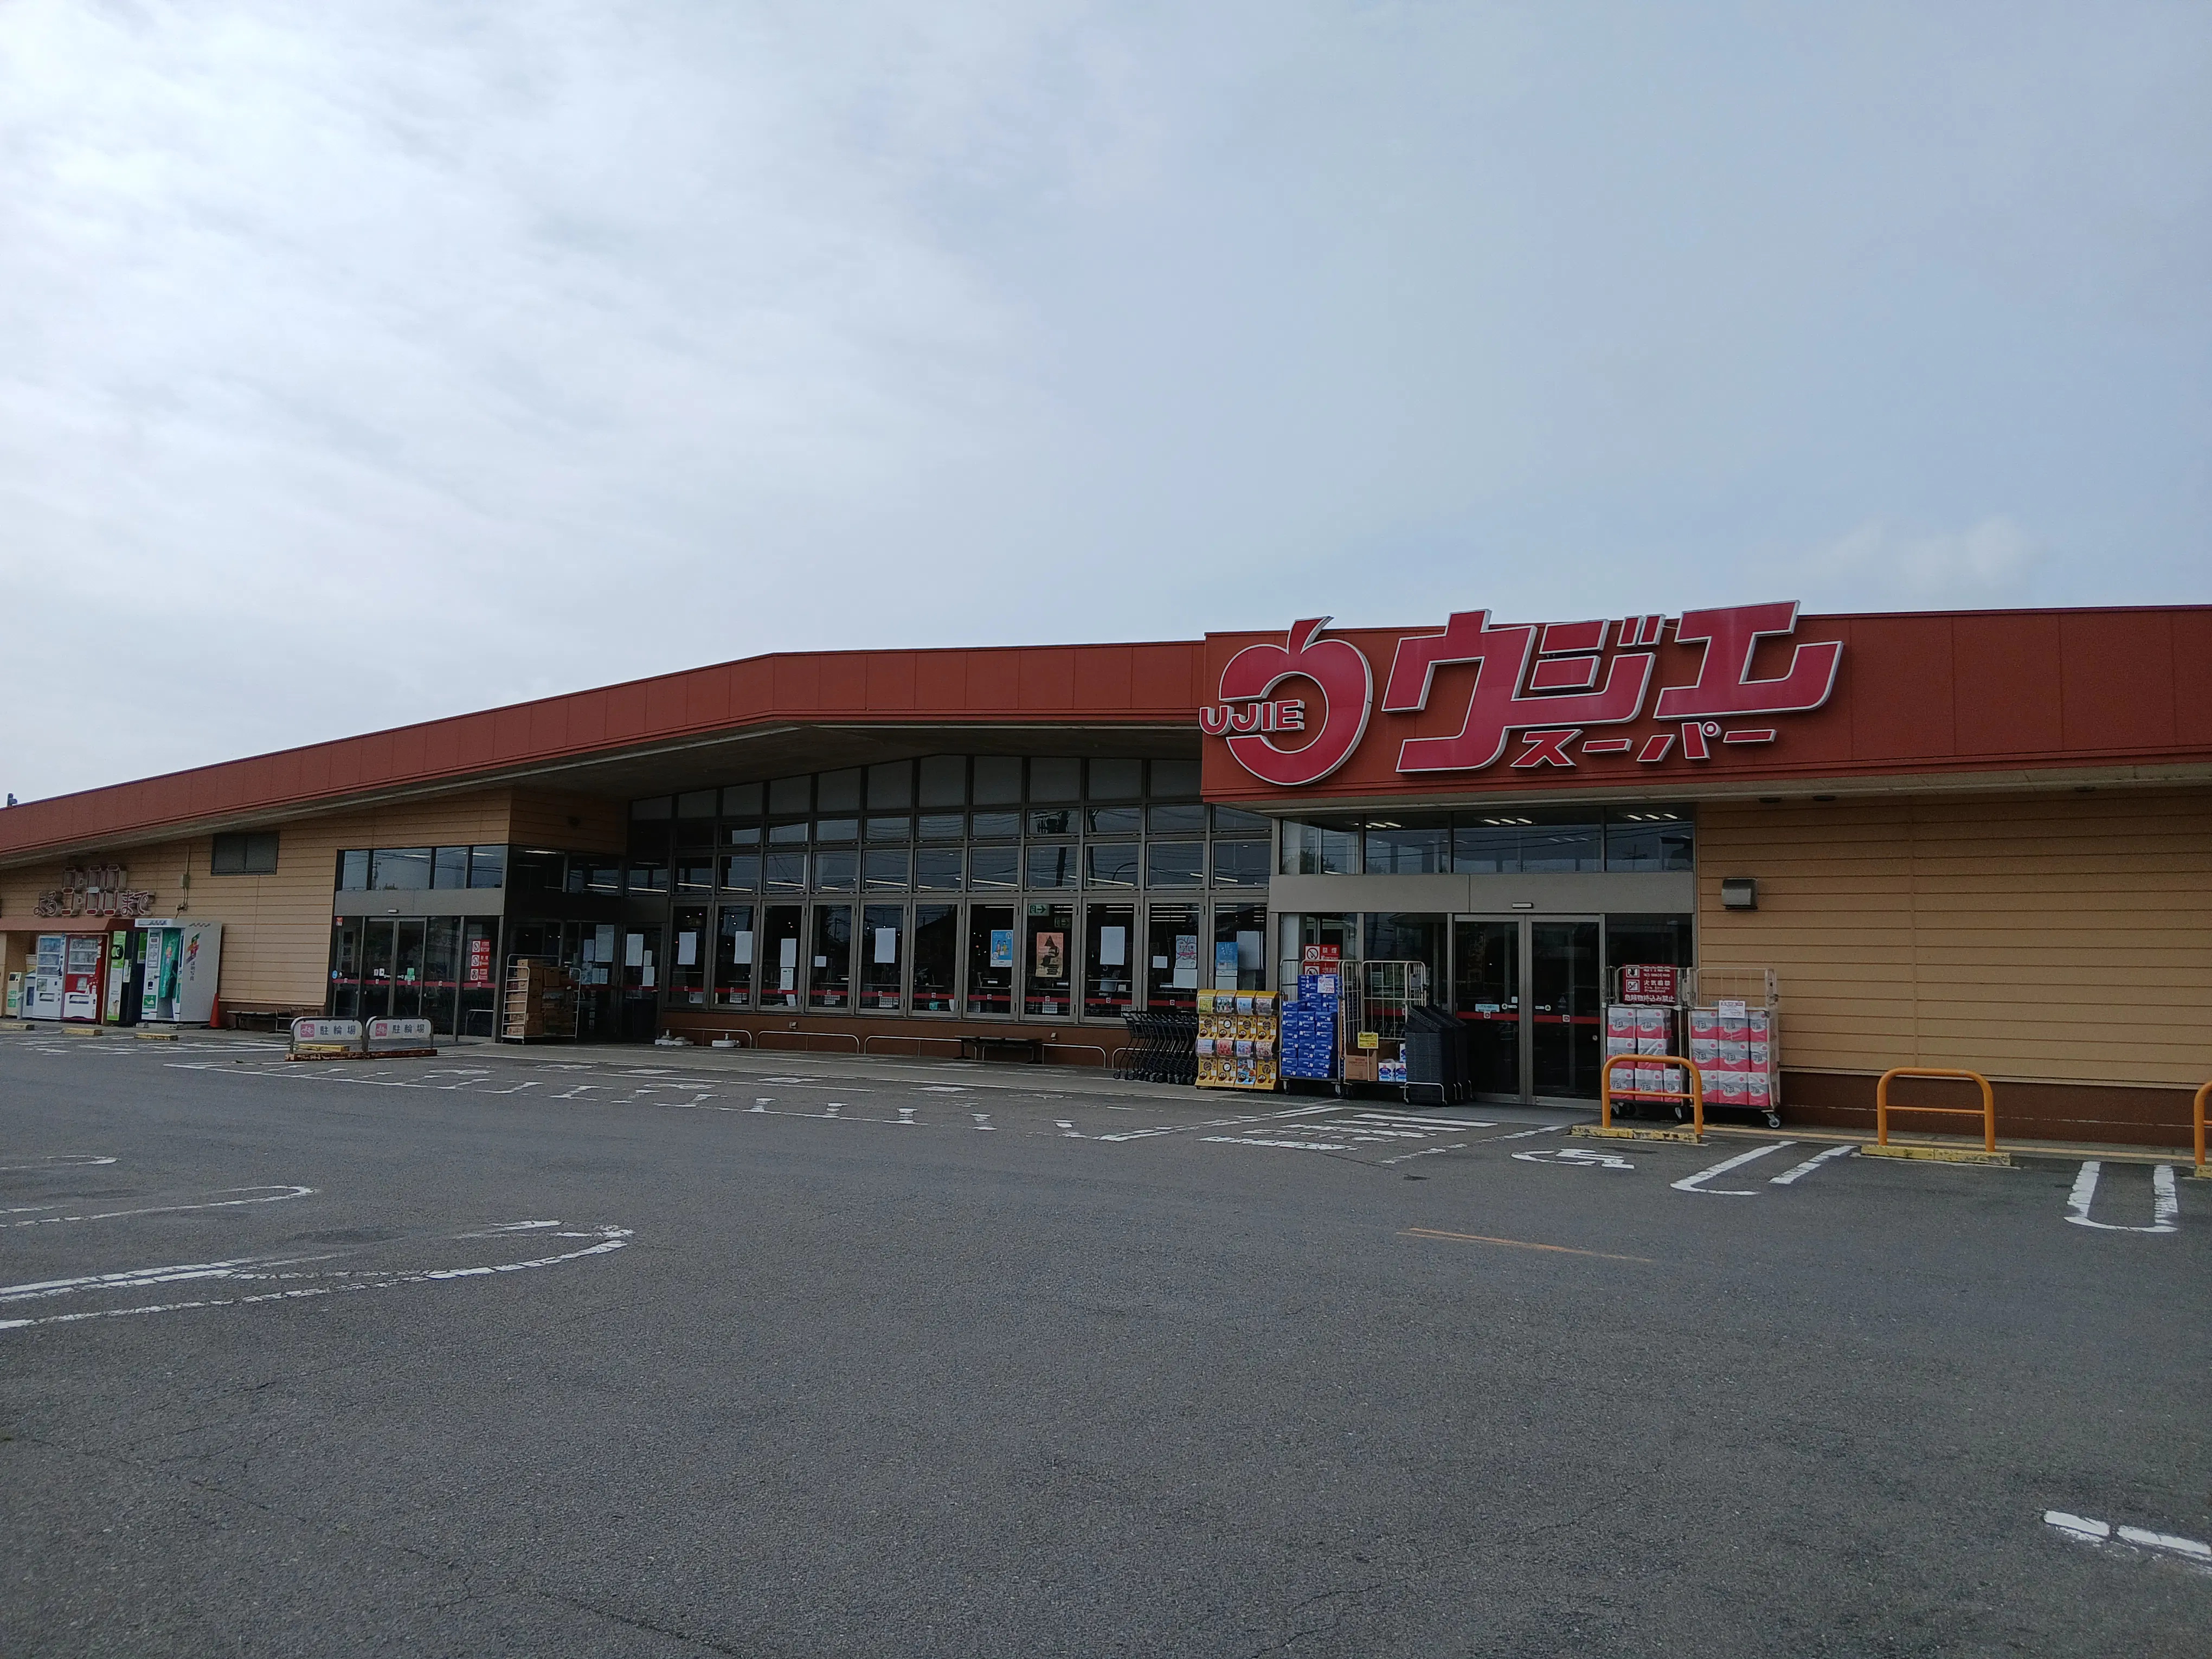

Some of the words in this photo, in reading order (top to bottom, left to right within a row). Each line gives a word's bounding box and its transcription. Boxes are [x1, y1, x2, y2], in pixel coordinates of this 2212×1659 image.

[1381, 599, 1844, 773] ウジエ
[1199, 699, 1304, 736] UJIE
[1509, 720, 1777, 768] スーパー
[320, 1024, 356, 1036] 駐輪場
[392, 1024, 425, 1034] 駐輪場
